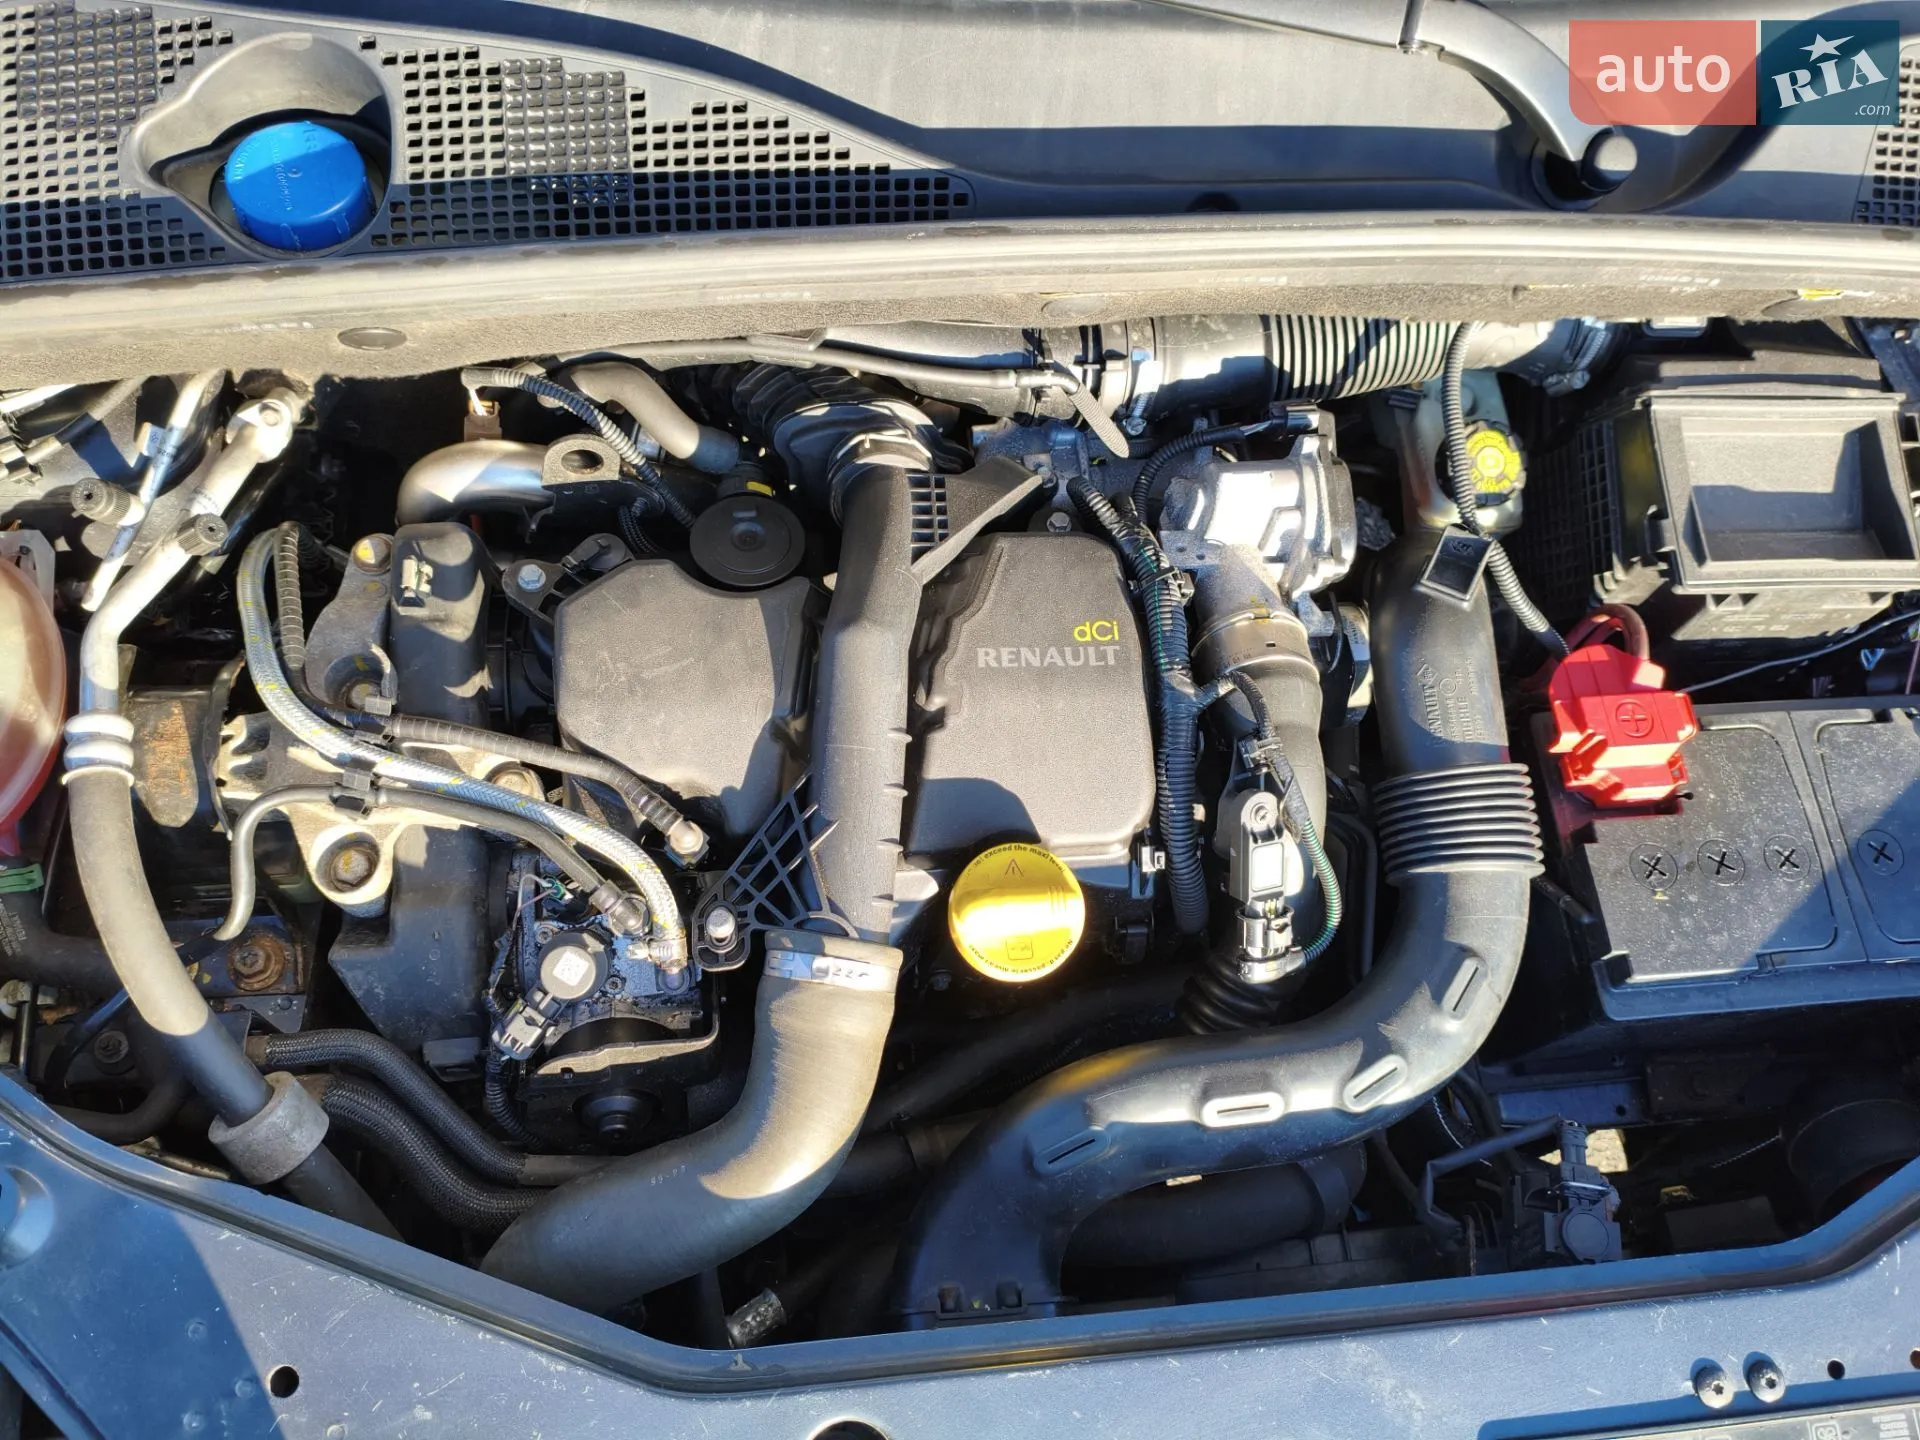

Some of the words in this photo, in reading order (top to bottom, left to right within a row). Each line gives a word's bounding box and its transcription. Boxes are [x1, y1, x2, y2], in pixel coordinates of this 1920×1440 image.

[1073, 620, 1119, 642] dCi
[976, 645, 1120, 668] RENAULT
[984, 844, 1013, 859] exceed
[1013, 844, 1028, 852] the
[1029, 846, 1049, 860] maxi
